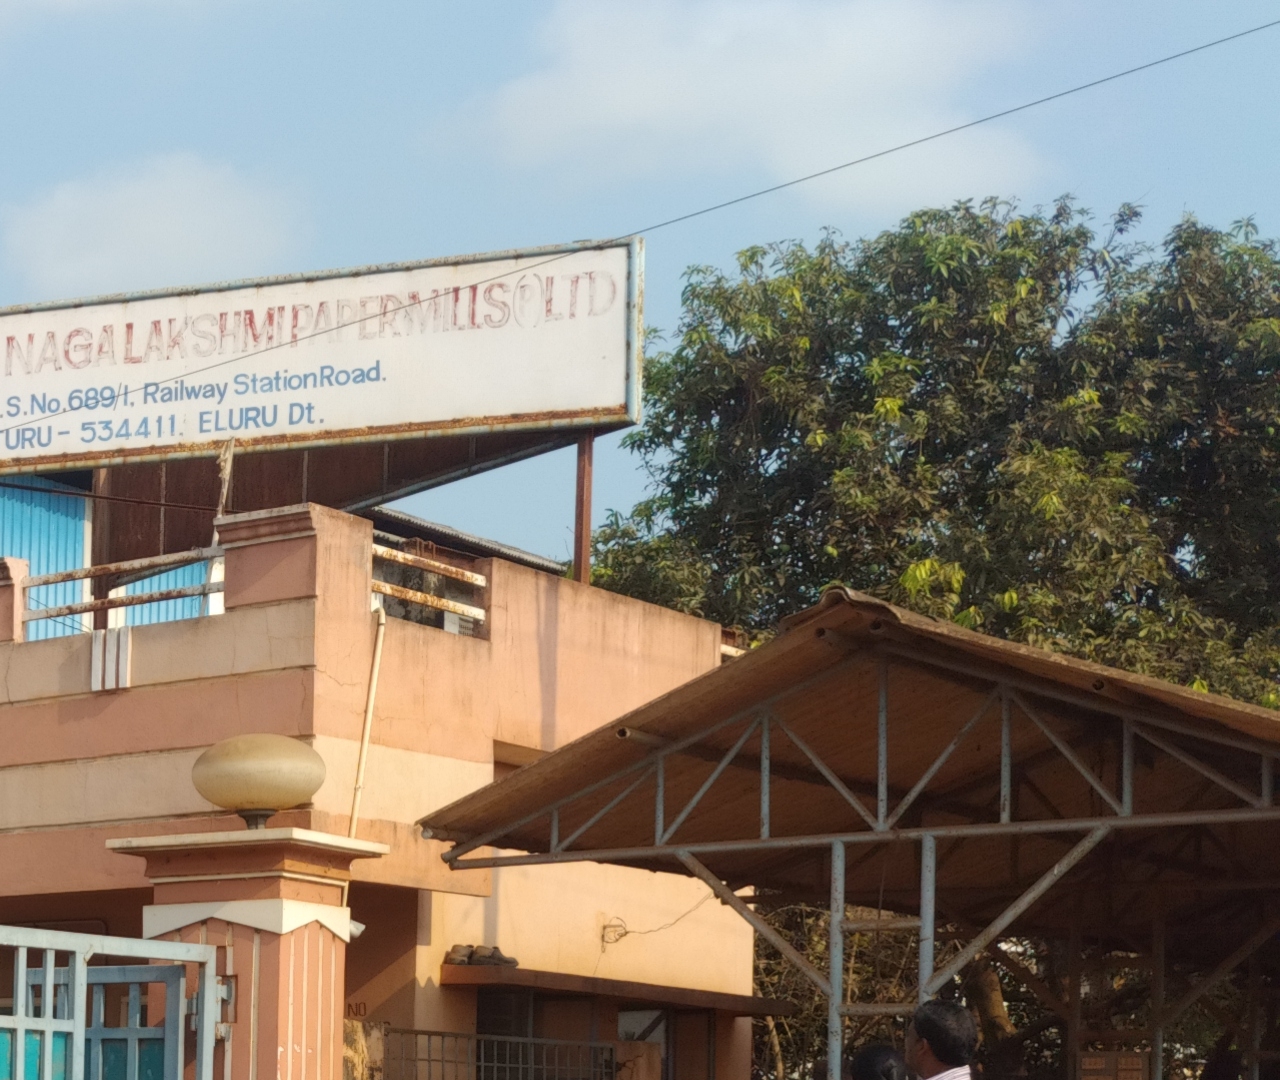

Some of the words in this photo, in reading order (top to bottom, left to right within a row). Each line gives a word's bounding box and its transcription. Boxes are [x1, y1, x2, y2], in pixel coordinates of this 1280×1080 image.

[5, 324, 117, 377] NAGA
[143, 379, 228, 405] Railway
[199, 404, 278, 434] ELURU
[289, 402, 325, 425] Dt.
